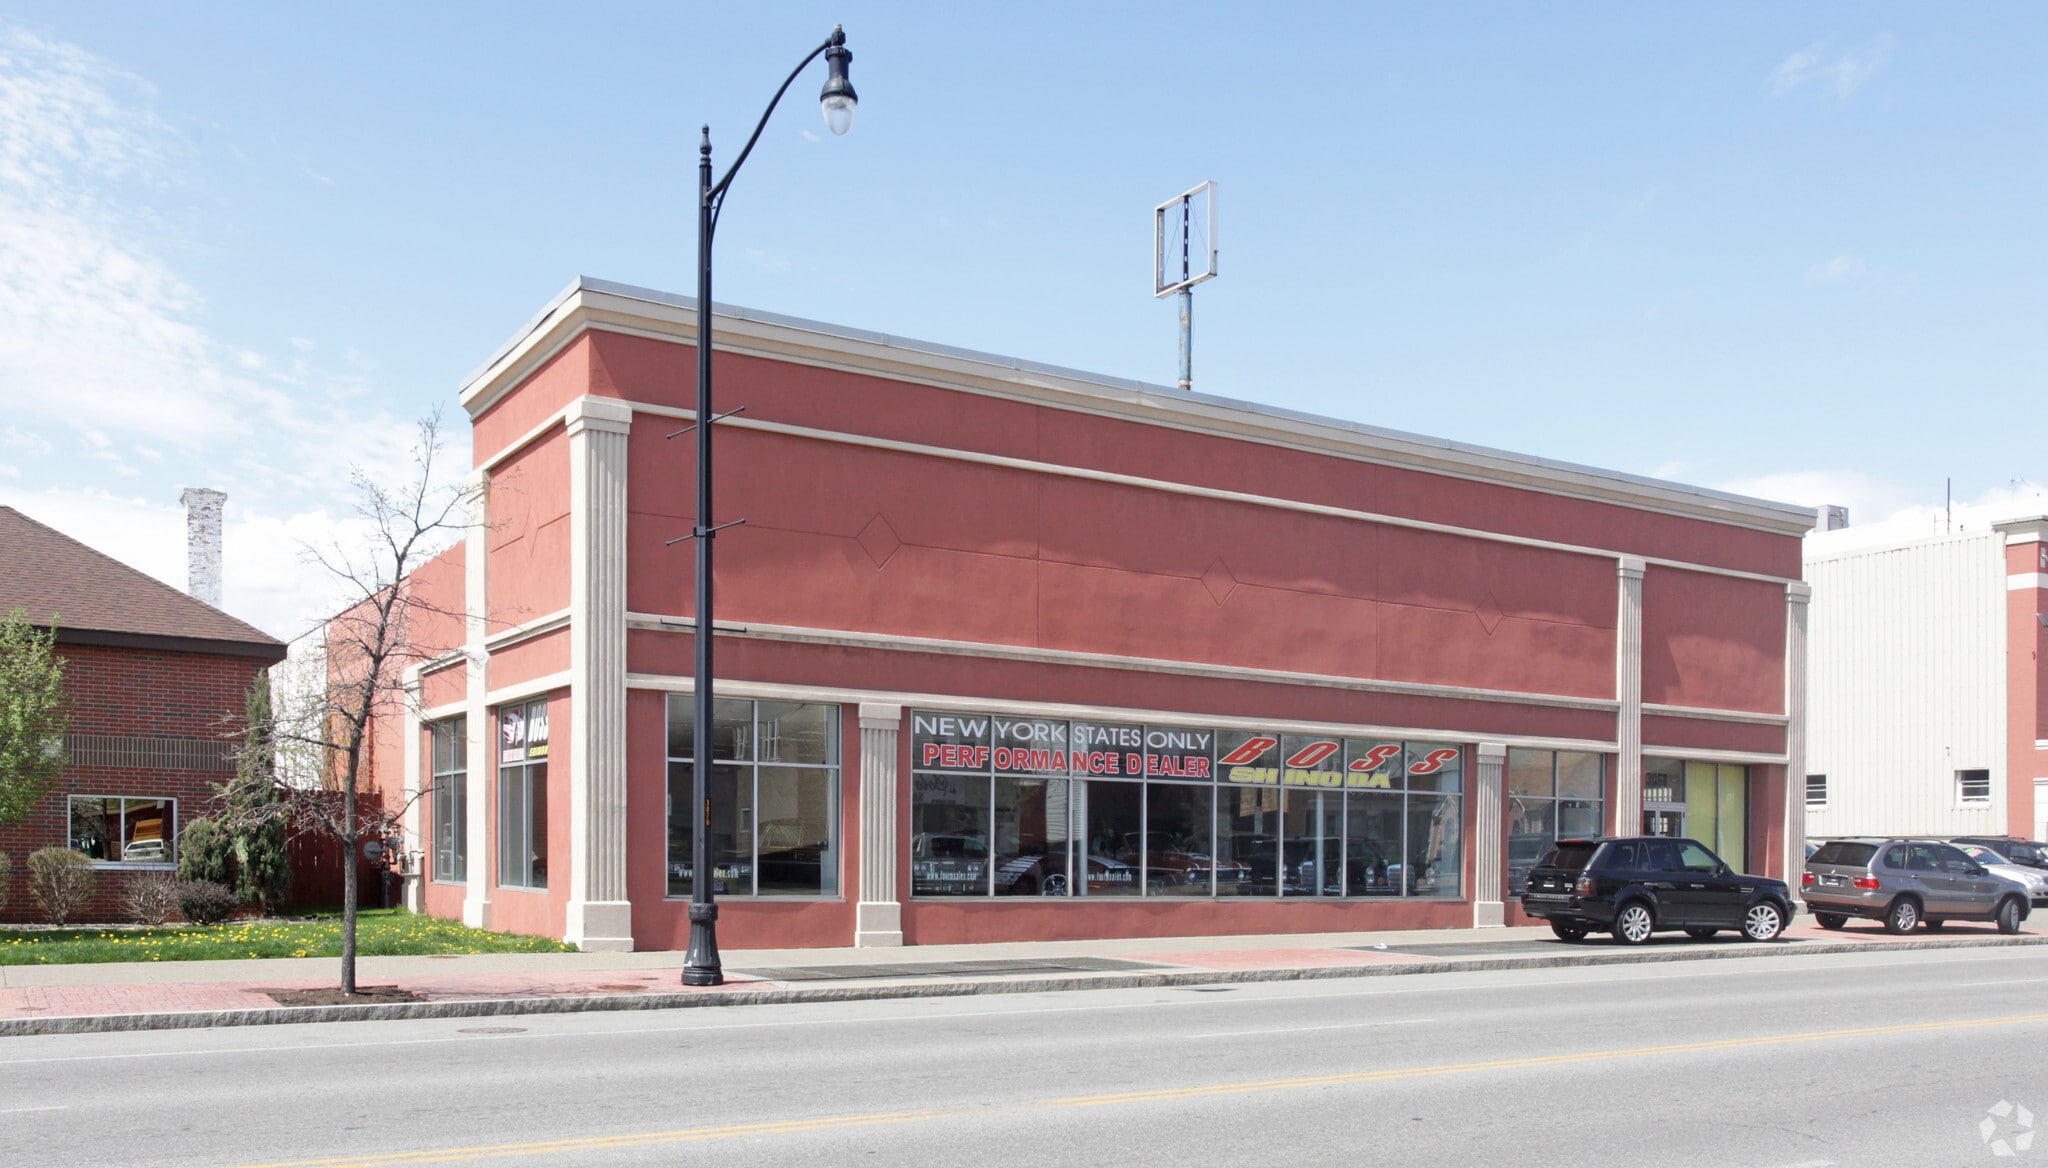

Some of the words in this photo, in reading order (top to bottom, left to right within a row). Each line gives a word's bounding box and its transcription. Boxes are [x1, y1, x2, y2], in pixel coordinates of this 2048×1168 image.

[914, 715, 987, 738] NEW
[994, 720, 1065, 743] YORK
[1074, 726, 1142, 747] STATES
[1146, 730, 1210, 750] ONLY
[923, 742, 1119, 774] PERFORMANCE
[1126, 752, 1210, 778] DEALER
[1218, 736, 1459, 775] BOSS
[1229, 766, 1391, 789] SHINODA
